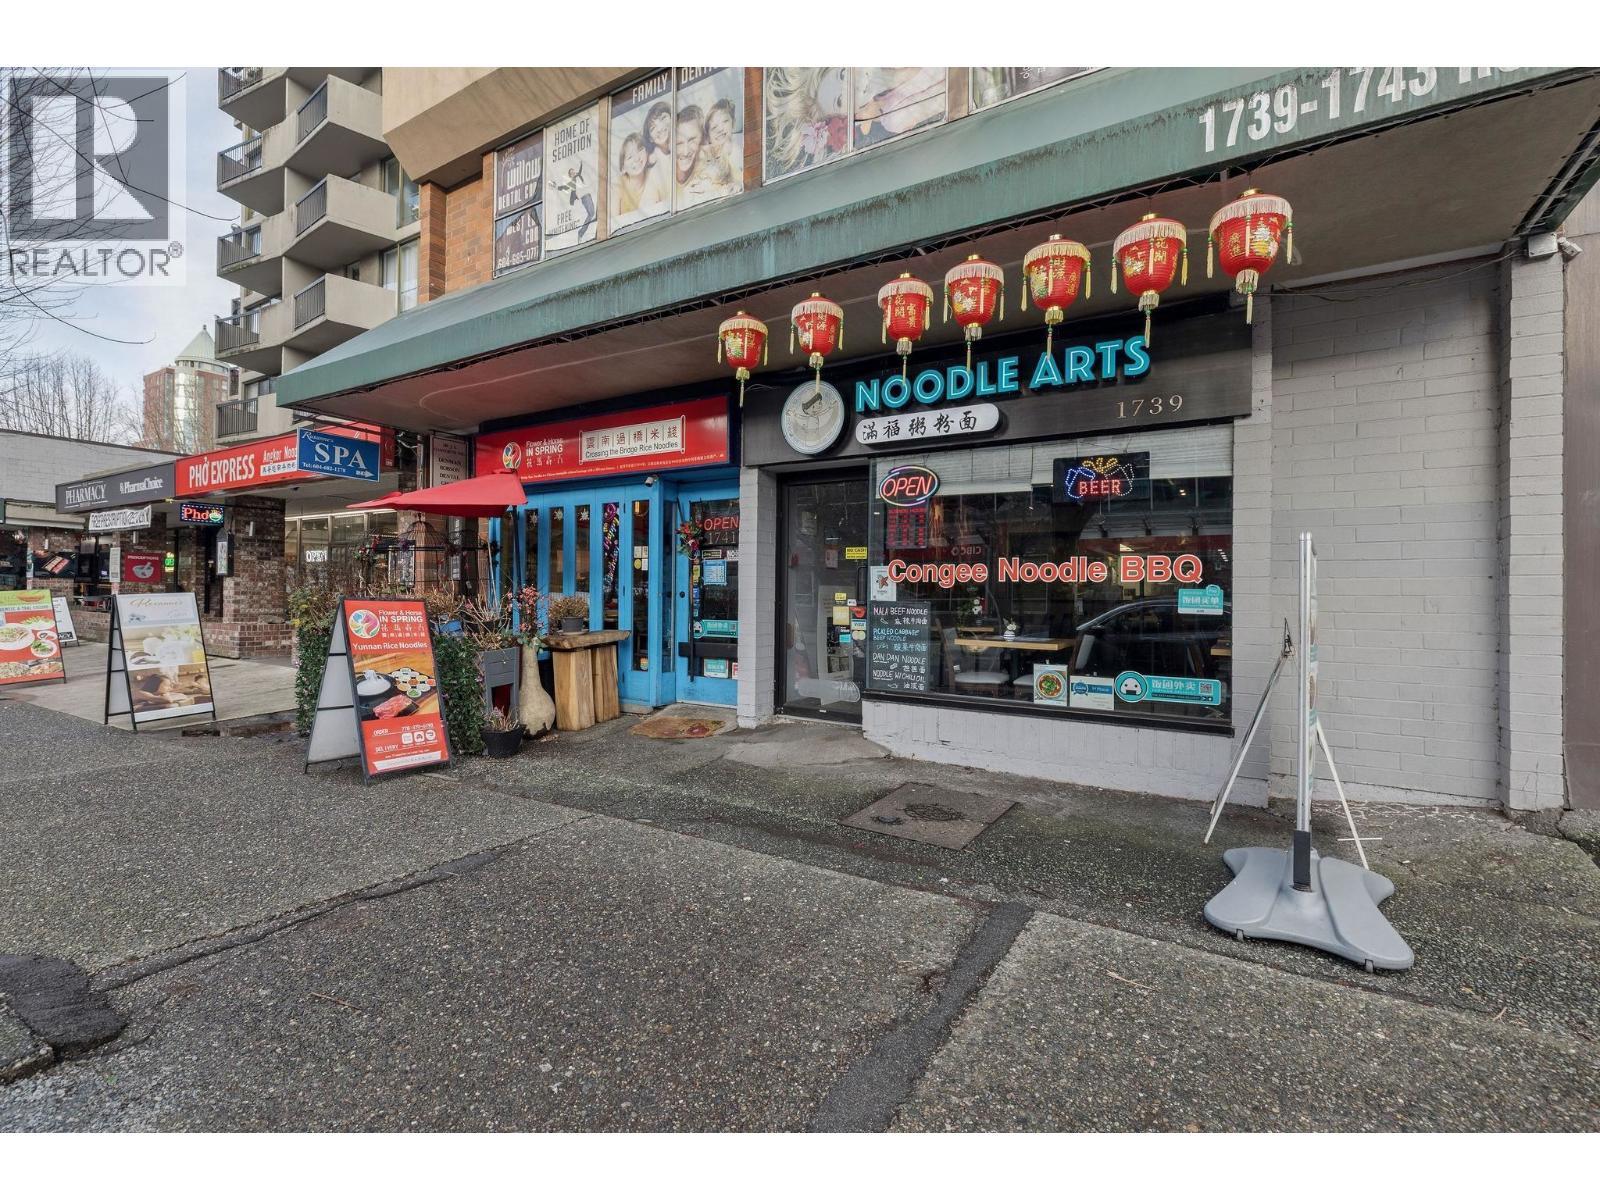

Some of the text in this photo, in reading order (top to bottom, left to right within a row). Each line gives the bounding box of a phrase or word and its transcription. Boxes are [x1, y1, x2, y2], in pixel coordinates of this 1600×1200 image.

[632, 72, 668, 104] FAMILY
[554, 118, 591, 146] HOME OF
[557, 209, 573, 225] FREE
[855, 335, 1151, 412] NOODLE ARTS
[1115, 395, 1184, 419] 1739
[314, 442, 368, 470] SPA
[526, 443, 564, 456] IN SPRING
[585, 449, 609, 459] Crossing
[619, 445, 638, 454] Bridge
[639, 443, 653, 451] Rice
[654, 441, 679, 450] Noodles
[211, 454, 255, 485] EXPRESS
[65, 484, 106, 505] PHARMACY
[882, 476, 932, 497] OPEN
[1079, 479, 1121, 495] BEER
[704, 516, 738, 531] OPEN
[708, 531, 737, 545] 1741
[305, 550, 327, 562] OPEN
[887, 554, 1204, 589] Congee Noodle BBQ
[390, 615, 424, 623] SPRING
[873, 607, 928, 616] MALA BEEF NOODLE
[353, 642, 383, 650] Yunnan
[399, 641, 428, 649] Noodles
[872, 652, 927, 664] DAN DAN NOODLE
[872, 670, 894, 678] NOODLE
